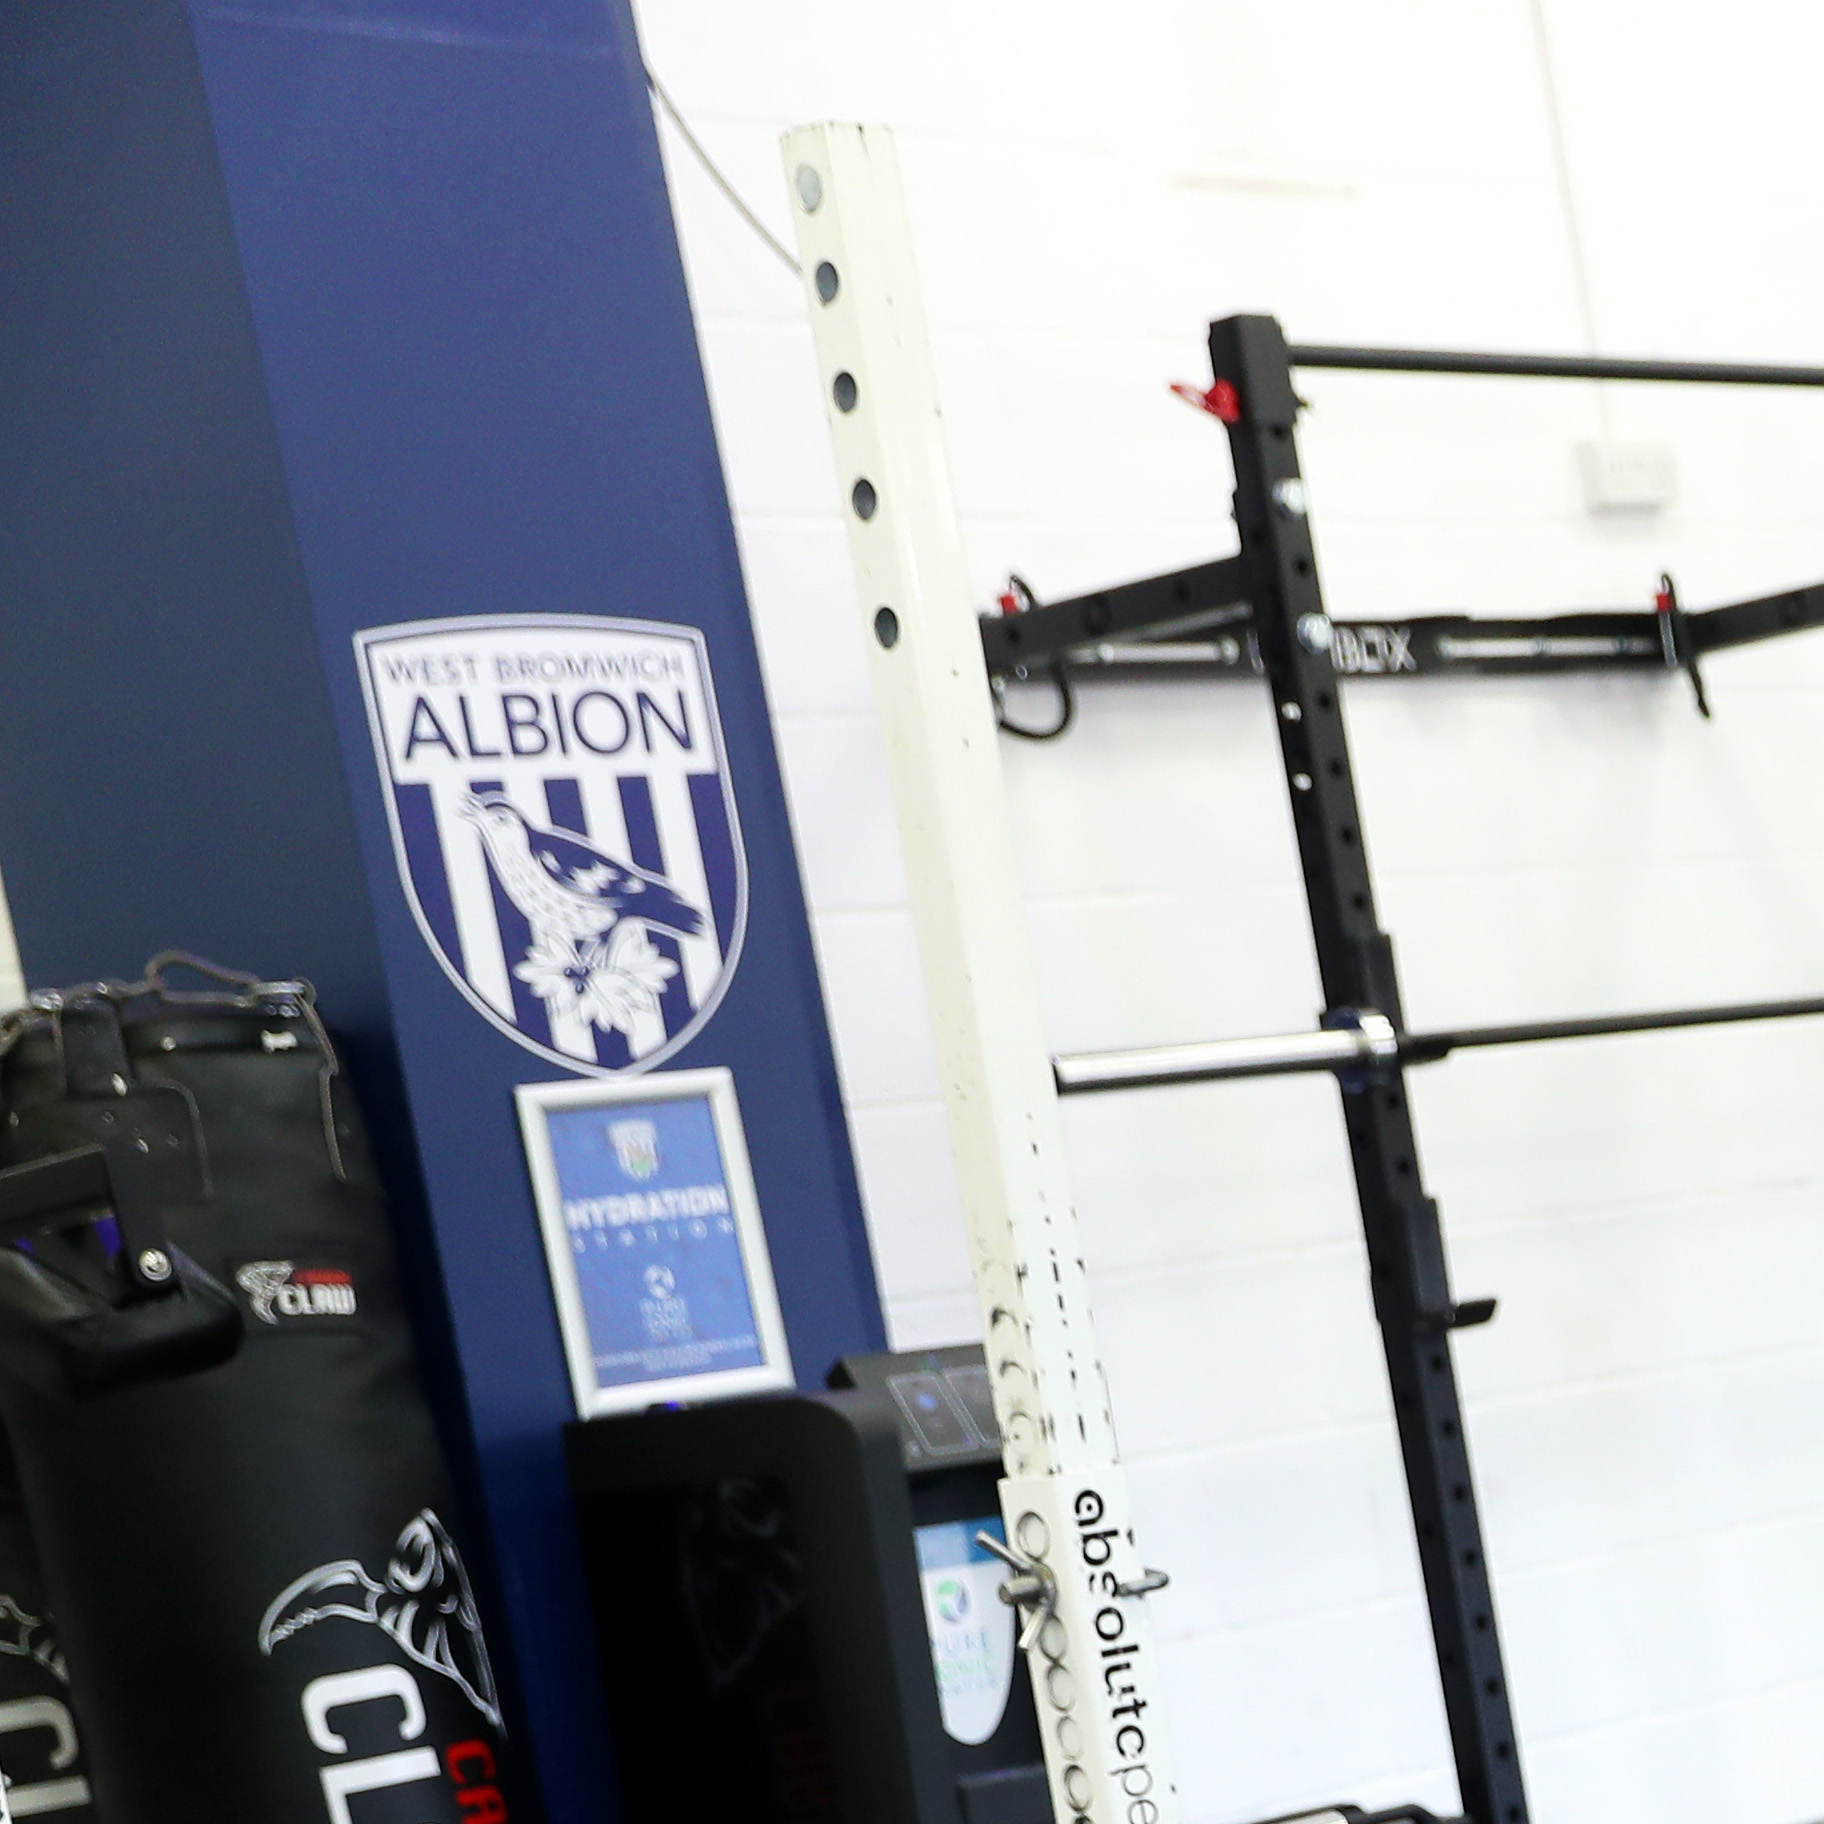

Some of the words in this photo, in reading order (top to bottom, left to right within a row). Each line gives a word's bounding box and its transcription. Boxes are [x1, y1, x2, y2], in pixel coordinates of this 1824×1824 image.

[384, 652, 482, 685] WEST
[496, 651, 685, 684] BROMWICH
[405, 689, 692, 760] ALBION
[565, 1184, 731, 1231] HYDRATION
